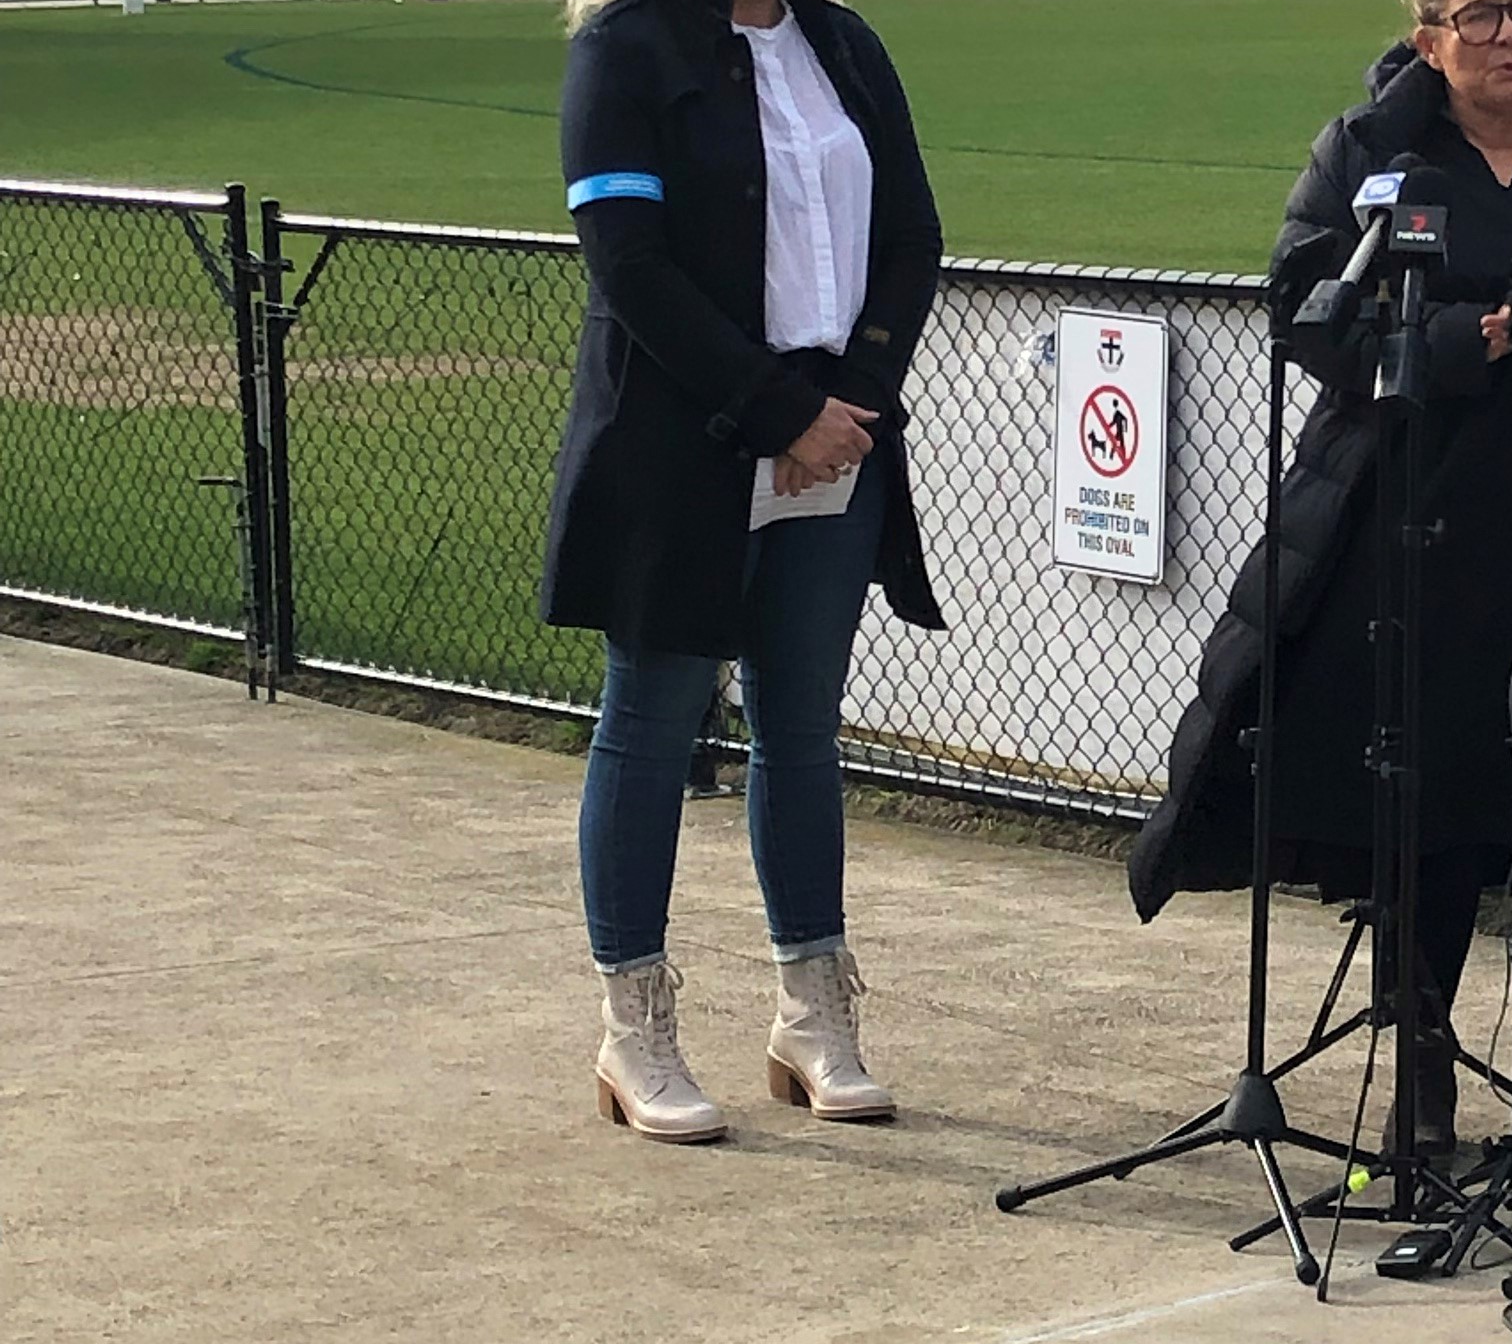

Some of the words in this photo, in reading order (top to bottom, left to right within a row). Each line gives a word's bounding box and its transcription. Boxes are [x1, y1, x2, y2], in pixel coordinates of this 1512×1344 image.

[1079, 486, 1110, 507] DOGS
[1113, 492, 1135, 512] ARE
[1064, 506, 1129, 533] PROHIBITED
[1133, 517, 1149, 537] ON
[1077, 531, 1103, 552] THIS
[1106, 536, 1135, 558] OVAL
